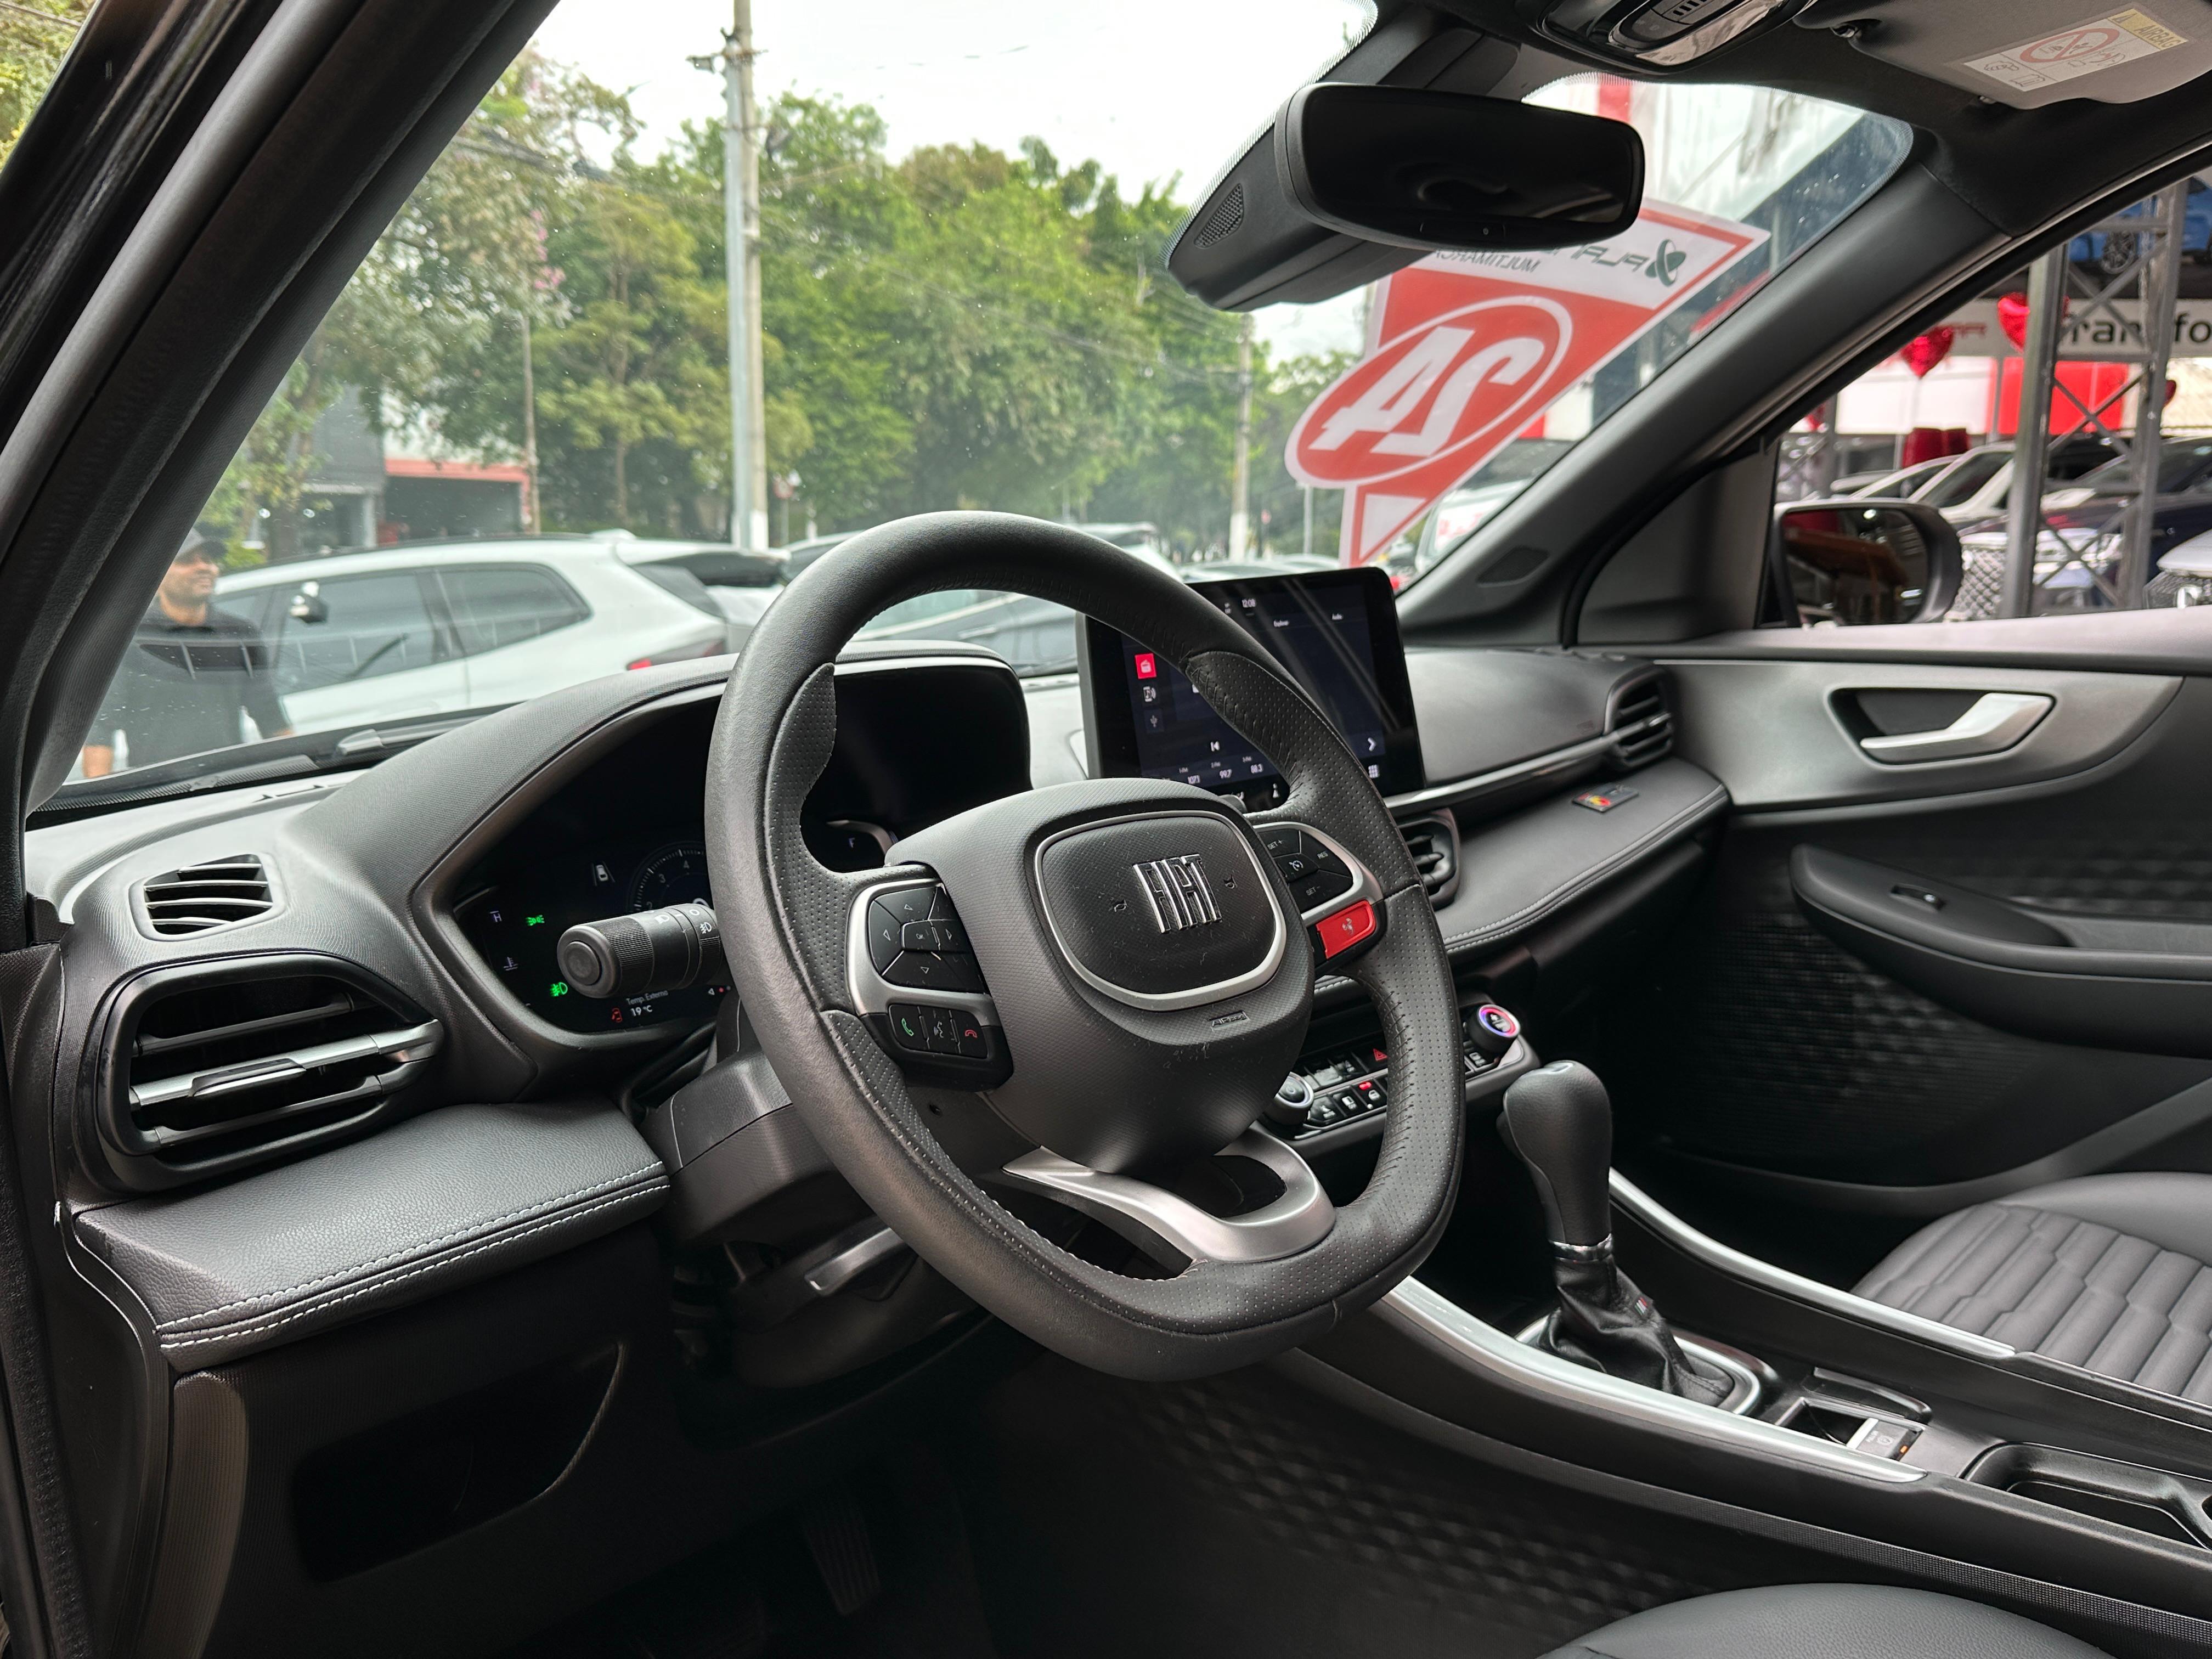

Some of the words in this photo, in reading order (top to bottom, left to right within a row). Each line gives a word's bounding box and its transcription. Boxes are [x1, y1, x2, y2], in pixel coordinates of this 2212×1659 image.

[2132, 25, 2181, 47] AIRBAG
[1267, 841, 1278, 850] SET
[1317, 851, 1328, 860] RES
[1132, 854, 1222, 934] FIAT
[1306, 887, 1317, 896] SET
[631, 1006, 642, 1017] 19
